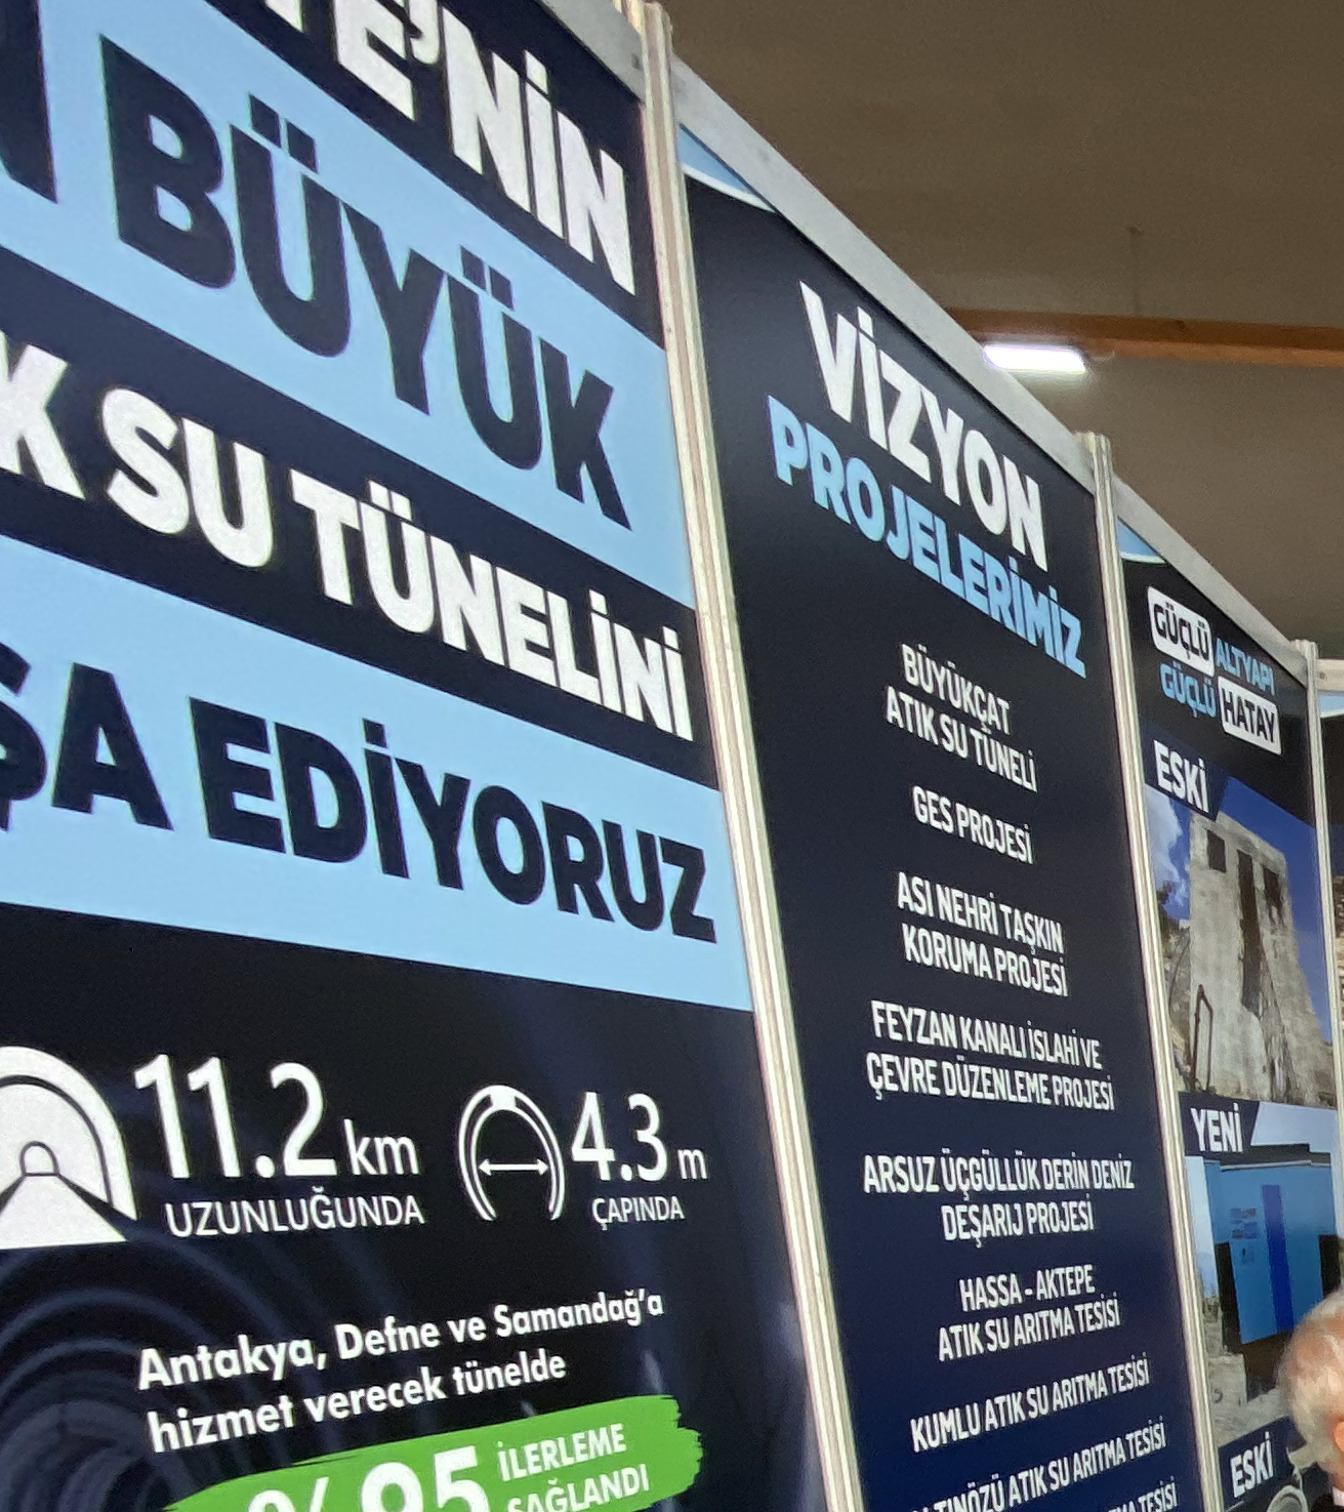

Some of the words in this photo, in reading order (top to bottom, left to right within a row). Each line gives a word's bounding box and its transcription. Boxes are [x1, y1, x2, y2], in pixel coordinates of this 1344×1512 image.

[99, 33, 632, 531] BÜYÜK
[800, 281, 1048, 572] VİZYON
[102, 388, 274, 567] SU
[289, 468, 693, 742] TÜNELİNİ
[768, 395, 1087, 679] PROJELERİMİZ
[902, 643, 1011, 735] BÜYÜKÇAT
[1153, 602, 1210, 661] GÜÇLÜ
[1216, 637, 1276, 696] ALTYAPI
[886, 685, 939, 746] ATIK
[939, 713, 969, 760] SU
[970, 726, 1038, 793] TÜNELİ
[1160, 660, 1217, 718] GÜÇLÜ
[1222, 687, 1276, 743] HATAY
[1153, 739, 1210, 813] ESKİ
[188, 697, 717, 944] EDİYORUZ
[912, 785, 954, 834] GES
[955, 803, 1033, 864] PROJESİ
[898, 872, 934, 917] ASI
[936, 883, 999, 936] NEHRİ
[999, 903, 1065, 955] TAŞKIN
[902, 923, 993, 980] KORUMA
[993, 947, 1069, 997] PROJESİ
[871, 1000, 958, 1049] FEYZAN
[959, 1016, 1026, 1059] KANALI
[1027, 1021, 1079, 1066] İSLAHİ
[1080, 1037, 1103, 1070] VE
[134, 1054, 338, 1180] 11.2
[344, 1119, 420, 1176] km
[866, 1052, 941, 1100] ÇEVRE
[941, 1055, 1052, 1106] DÜZENLEME
[1051, 1074, 1115, 1111] PROJESİ
[571, 1092, 668, 1183] 4.3
[678, 1146, 708, 1180] m
[1190, 1102, 1243, 1153] YENİ
[165, 1187, 425, 1239] UZUNLUĞUNDA
[592, 1194, 684, 1231] ÇAPINDA
[863, 1155, 940, 1193] ARSUZ
[940, 1147, 1041, 1201] ÜÇGÜLLÜK
[1041, 1151, 1090, 1190] DERİN
[1090, 1152, 1135, 1189] DENİZ
[941, 1203, 1024, 1248] DEŞARIJ
[1026, 1193, 1094, 1234] PROJESİ
[938, 1322, 984, 1362] ATIK
[985, 1317, 1011, 1352] SU
[1013, 1307, 1075, 1346] ARITMA
[1074, 1292, 1120, 1334] TESİSİ
[959, 1274, 1022, 1312] HASSA
[1036, 1264, 1095, 1300] AKTEPE
[138, 1336, 326, 1391] Antakya,
[336, 1315, 438, 1361] Defne
[450, 1314, 486, 1342] ve
[494, 1287, 663, 1337] Samandağ'a
[148, 1395, 295, 1453] hizmet
[305, 1374, 445, 1423] verecek
[453, 1349, 566, 1394] tünelde
[910, 1402, 980, 1452] KUMLU
[985, 1391, 1026, 1431] ATIK
[1027, 1385, 1049, 1419] SU
[1053, 1370, 1108, 1412] ARITMA
[1107, 1352, 1150, 1393] TESİSİ
[497, 1423, 627, 1482] İLERLEME
[1008, 1465, 1048, 1507] ATIK
[1048, 1457, 1069, 1491] SU
[1073, 1437, 1126, 1482] ARITMA
[1125, 1415, 1166, 1459] TESİSİ
[1229, 1432, 1274, 1499] ESKİ
